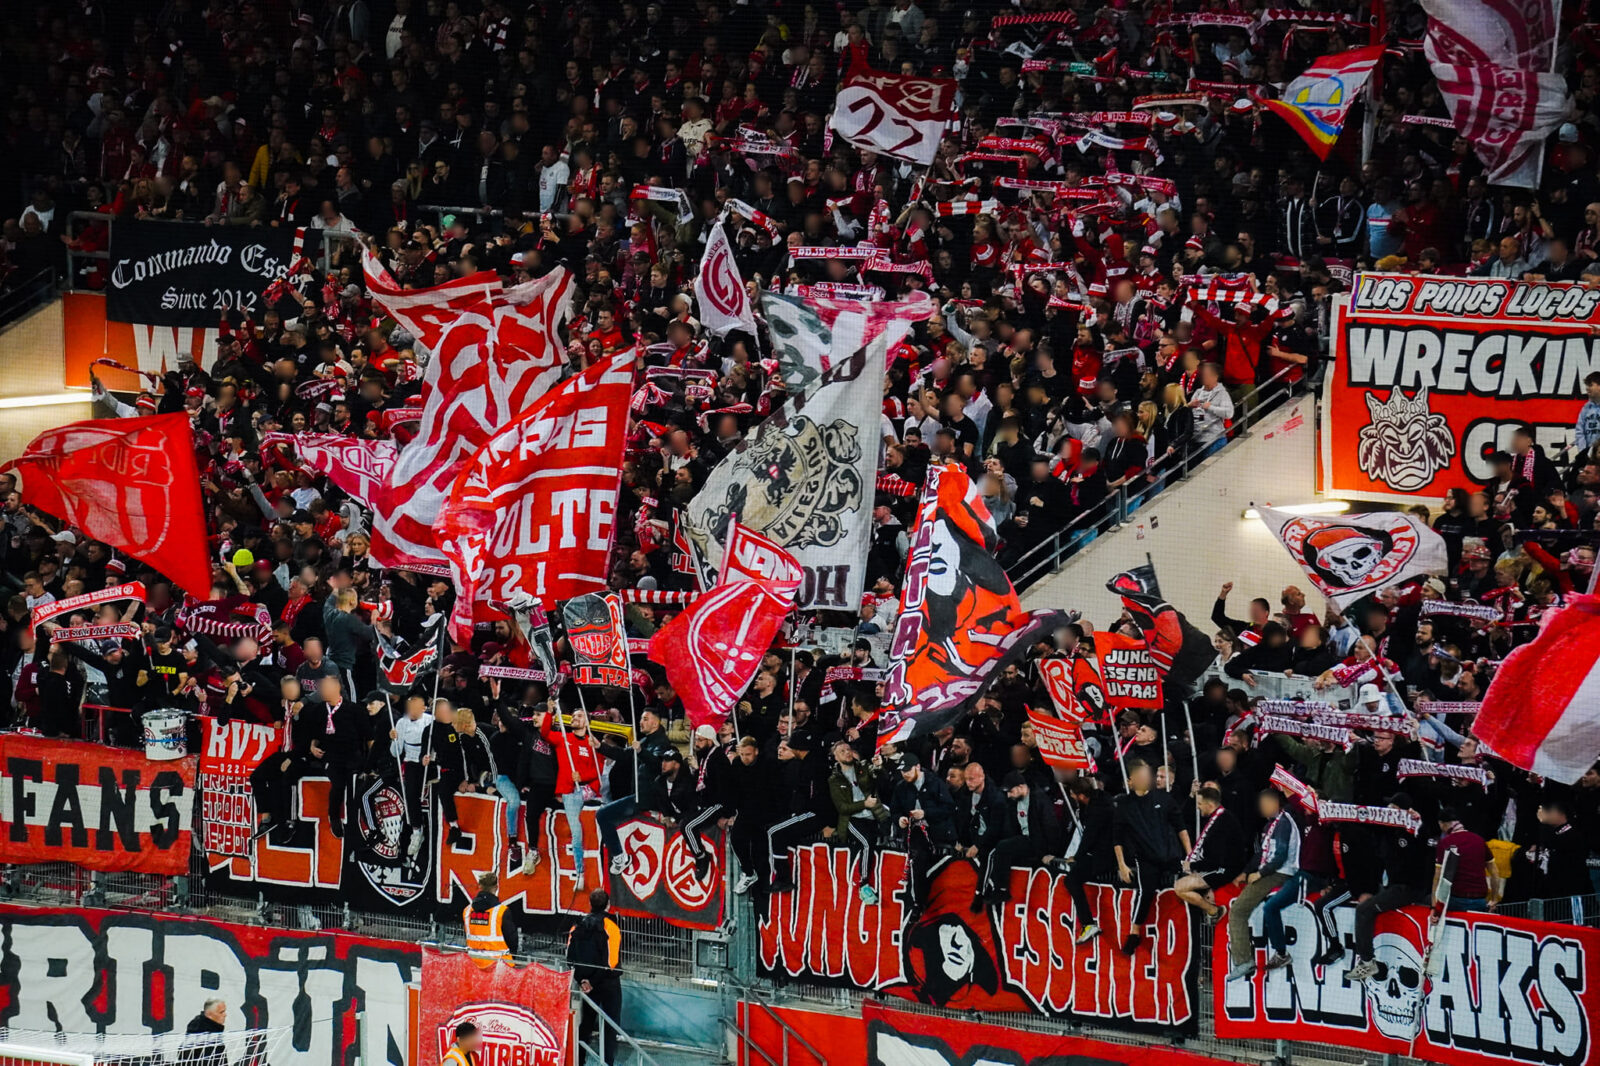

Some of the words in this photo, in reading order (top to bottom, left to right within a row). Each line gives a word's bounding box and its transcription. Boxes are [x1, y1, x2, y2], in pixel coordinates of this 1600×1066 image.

[111, 238, 232, 290] Commando
[161, 286, 207, 310] Since
[212, 288, 258, 313] 2012
[1356, 278, 1414, 313] LOS
[1504, 284, 1600, 320] LOCOS
[91, 586, 122, 602] ESSEN
[1105, 649, 1155, 665] JUNG
[1106, 682, 1158, 699] ULTRAS
[207, 718, 276, 762] RVT
[7, 757, 188, 853] FANS
[759, 842, 908, 989] JUNGE
[999, 865, 1194, 1027] ESSENER
[0, 923, 419, 1066] RIBÜN
